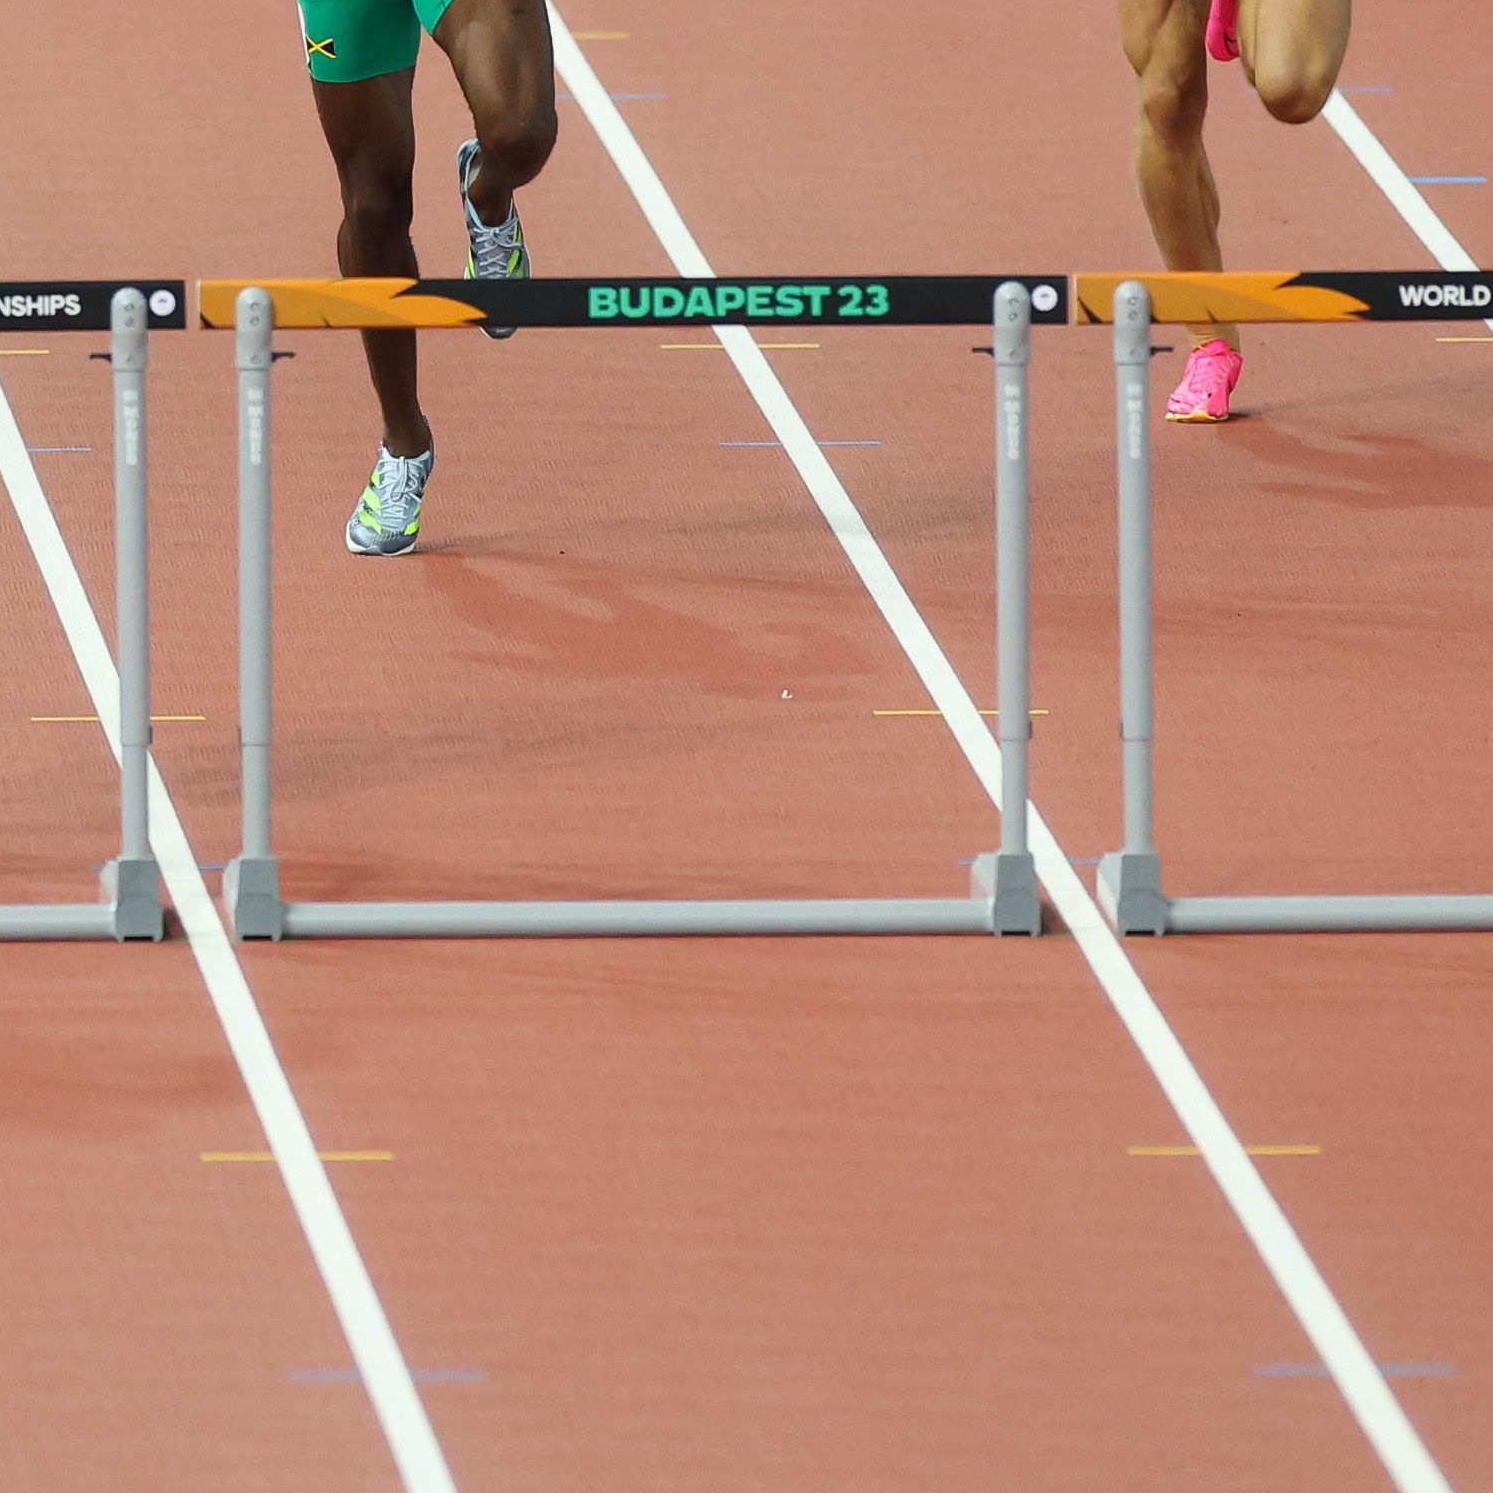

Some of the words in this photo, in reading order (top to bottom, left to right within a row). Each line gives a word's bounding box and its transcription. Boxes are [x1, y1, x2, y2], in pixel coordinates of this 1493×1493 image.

[588, 286, 830, 319] BUDAPEST
[837, 285, 889, 317] 23
[1399, 285, 1491, 307] WORLD
